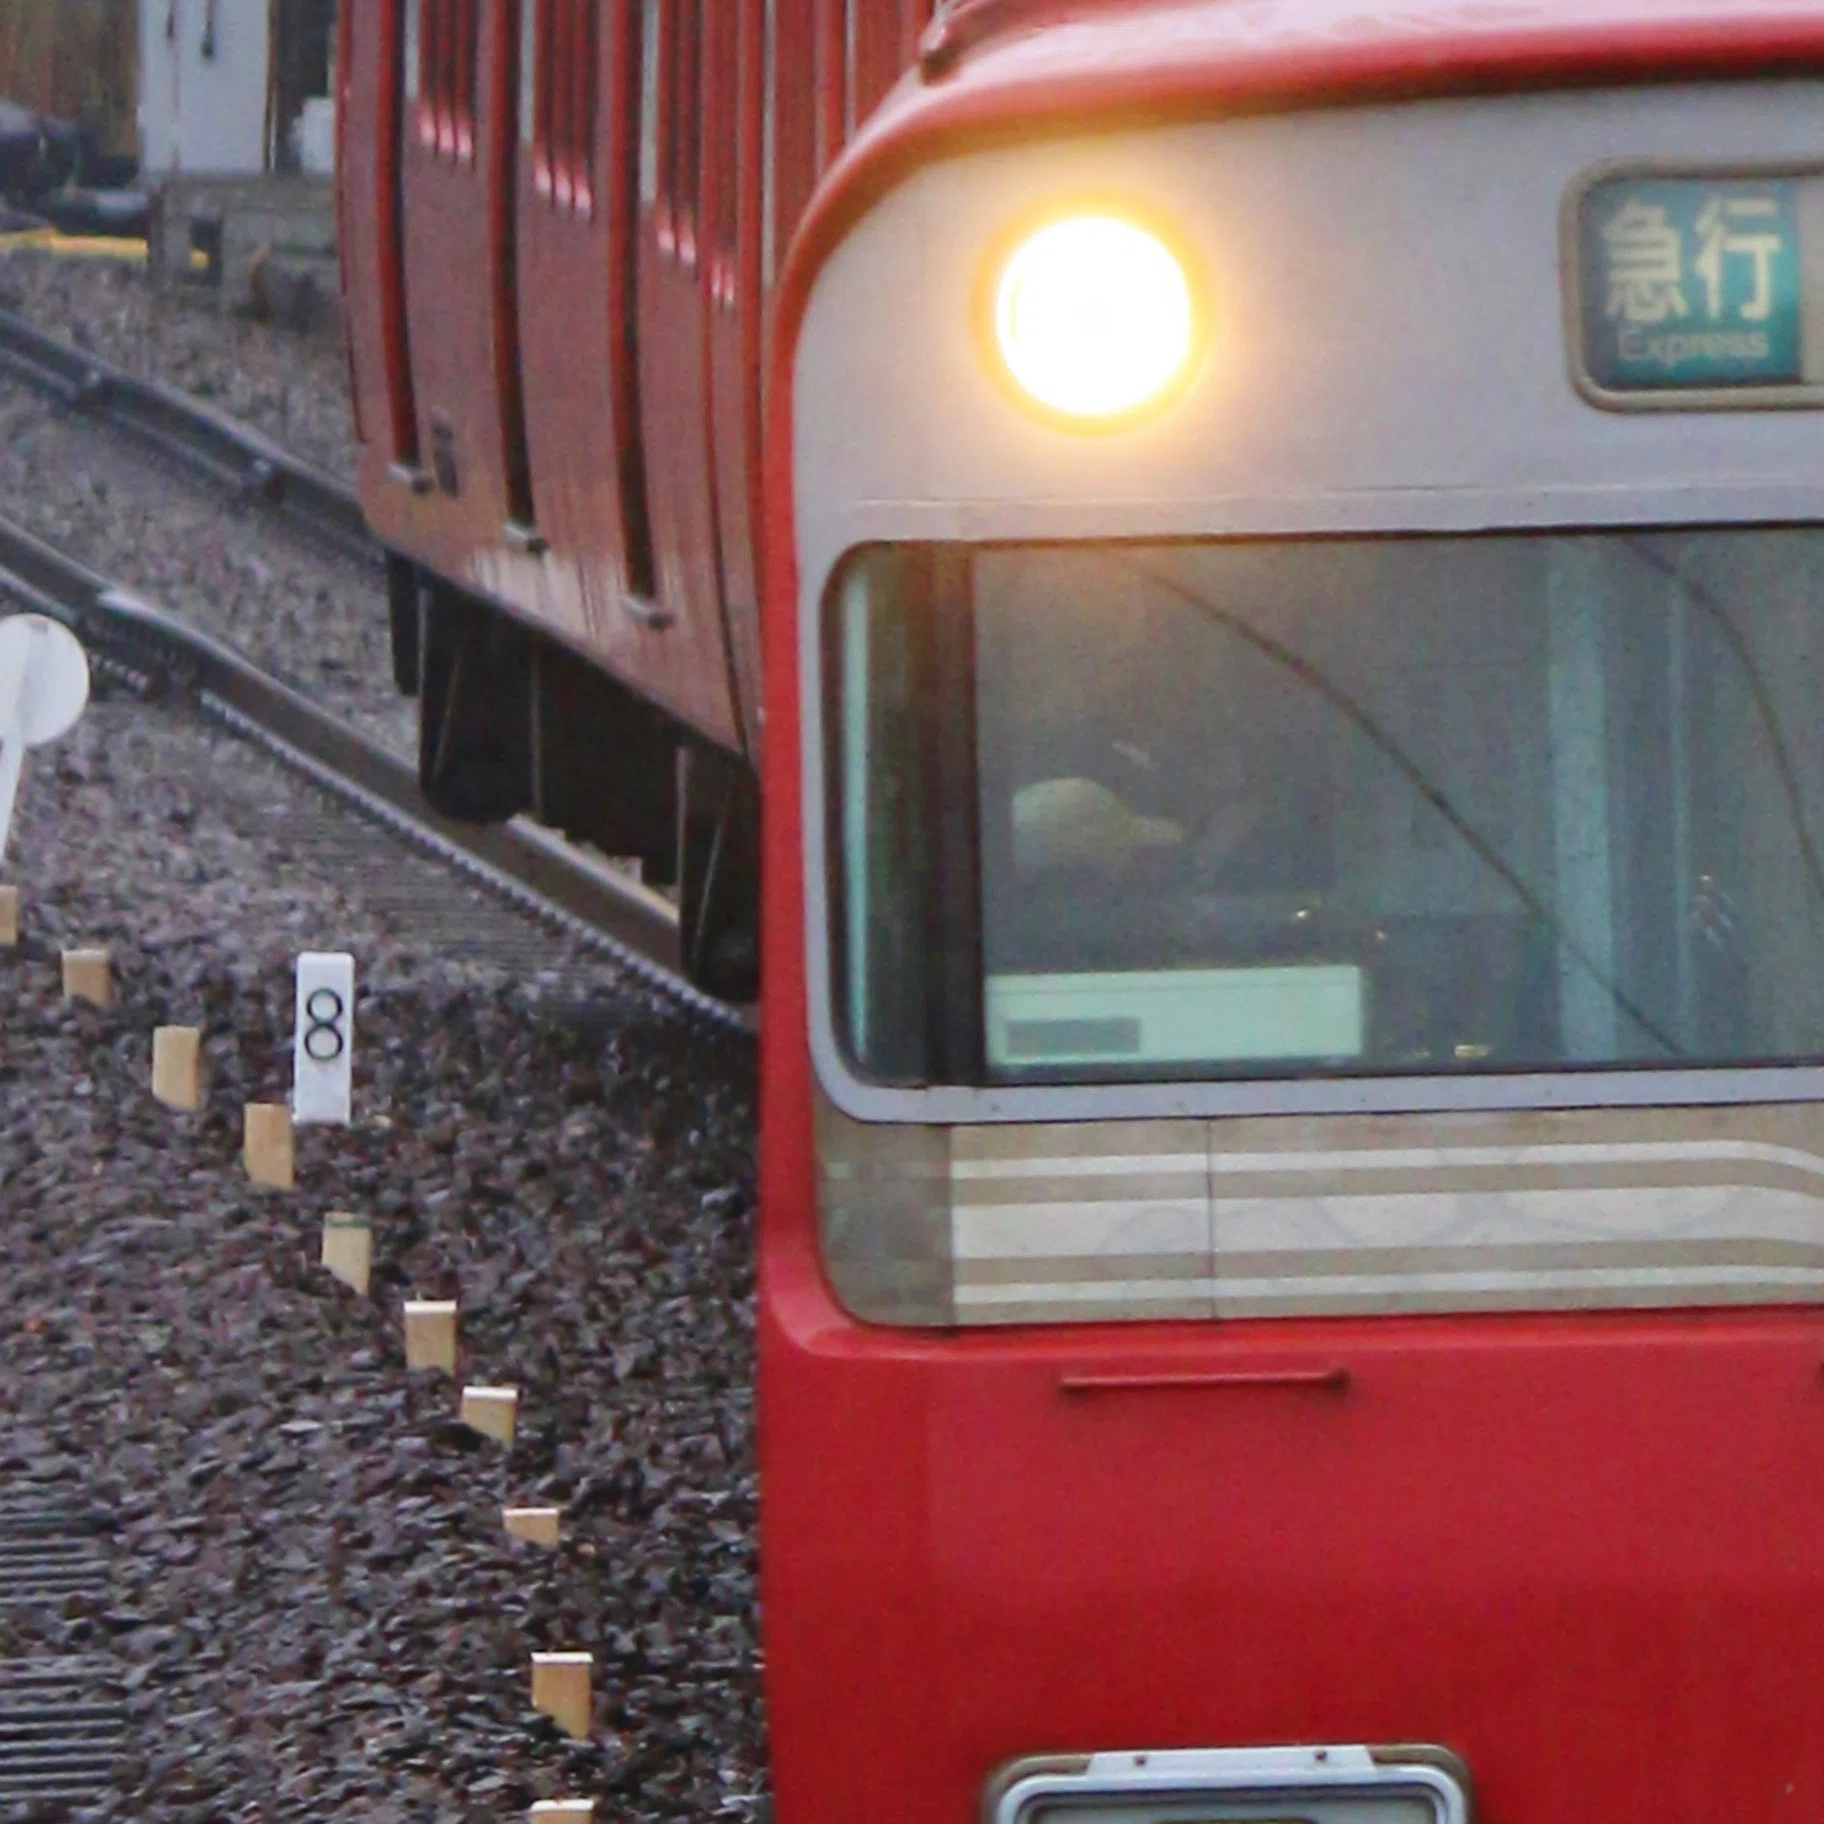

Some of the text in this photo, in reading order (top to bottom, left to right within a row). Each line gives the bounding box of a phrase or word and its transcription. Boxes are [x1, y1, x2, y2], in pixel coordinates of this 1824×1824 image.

[1602, 194, 1783, 324] 急行
[1616, 323, 1769, 369] Express
[304, 987, 343, 1062] 8
